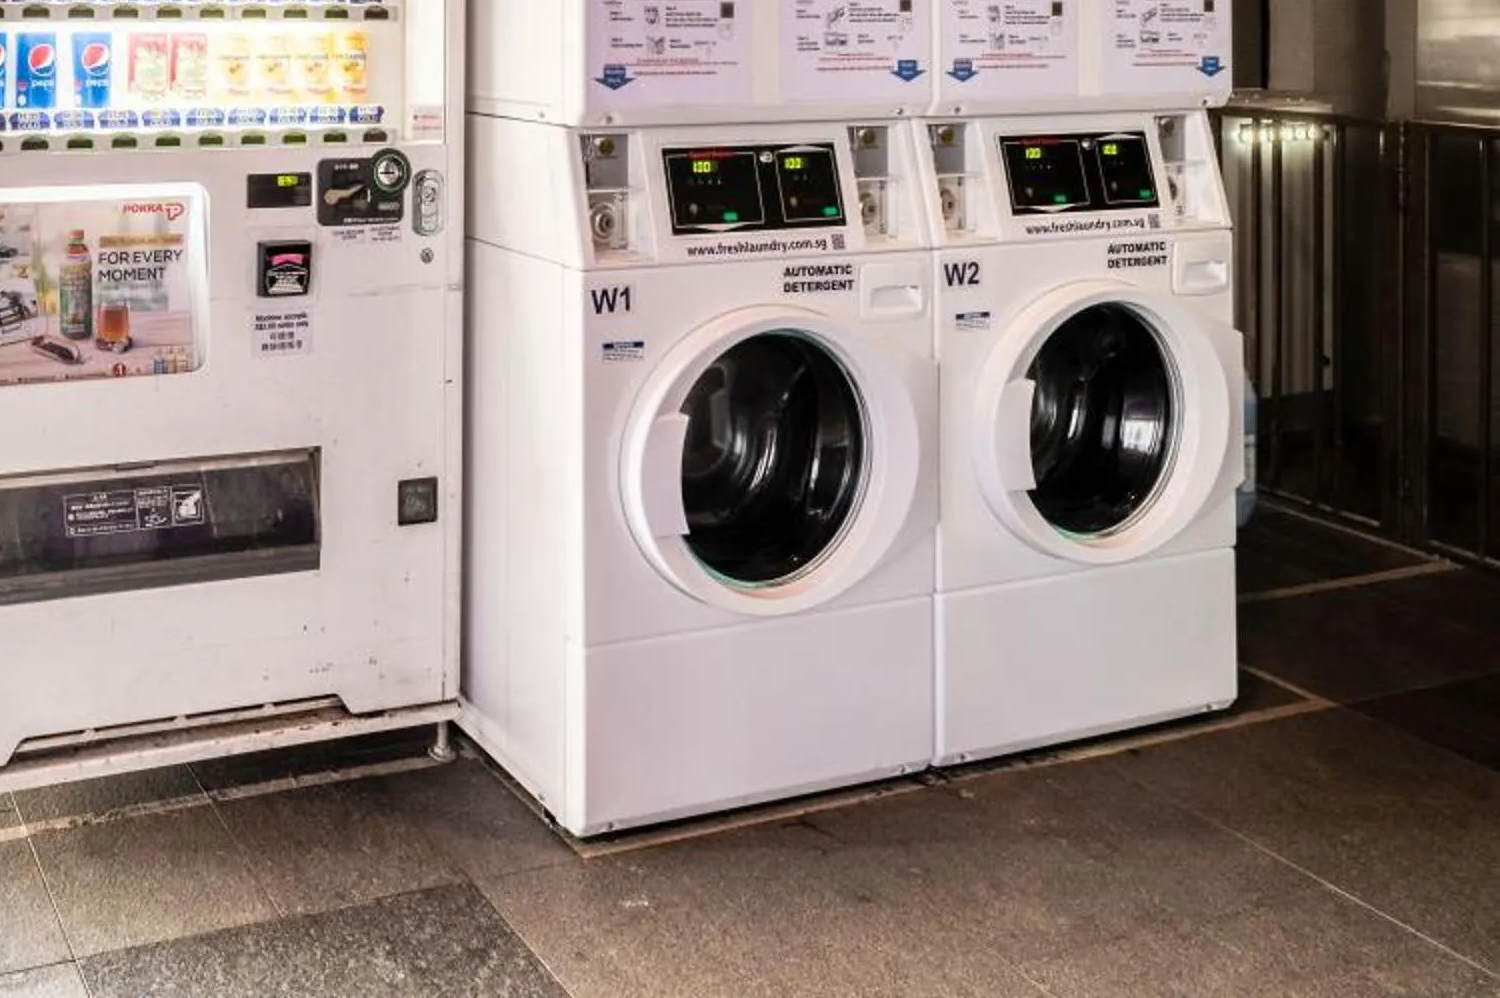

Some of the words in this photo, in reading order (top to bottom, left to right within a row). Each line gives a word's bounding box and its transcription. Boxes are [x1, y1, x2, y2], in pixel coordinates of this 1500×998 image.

[1025, 218, 1146, 236] www.freshlaundry.com.sg
[98, 250, 130, 265] FOR
[133, 248, 184, 264] EVERY
[687, 239, 827, 258] www.freshlaundry.com.sg
[1108, 241, 1167, 255] AUTOMATIC
[1107, 255, 1168, 269] DETERGENT
[98, 266, 166, 283] MOMENT
[783, 264, 853, 278] AUTOMATIC
[943, 261, 980, 287] W2
[783, 279, 855, 294] DETERGENT
[591, 286, 632, 314] W1
